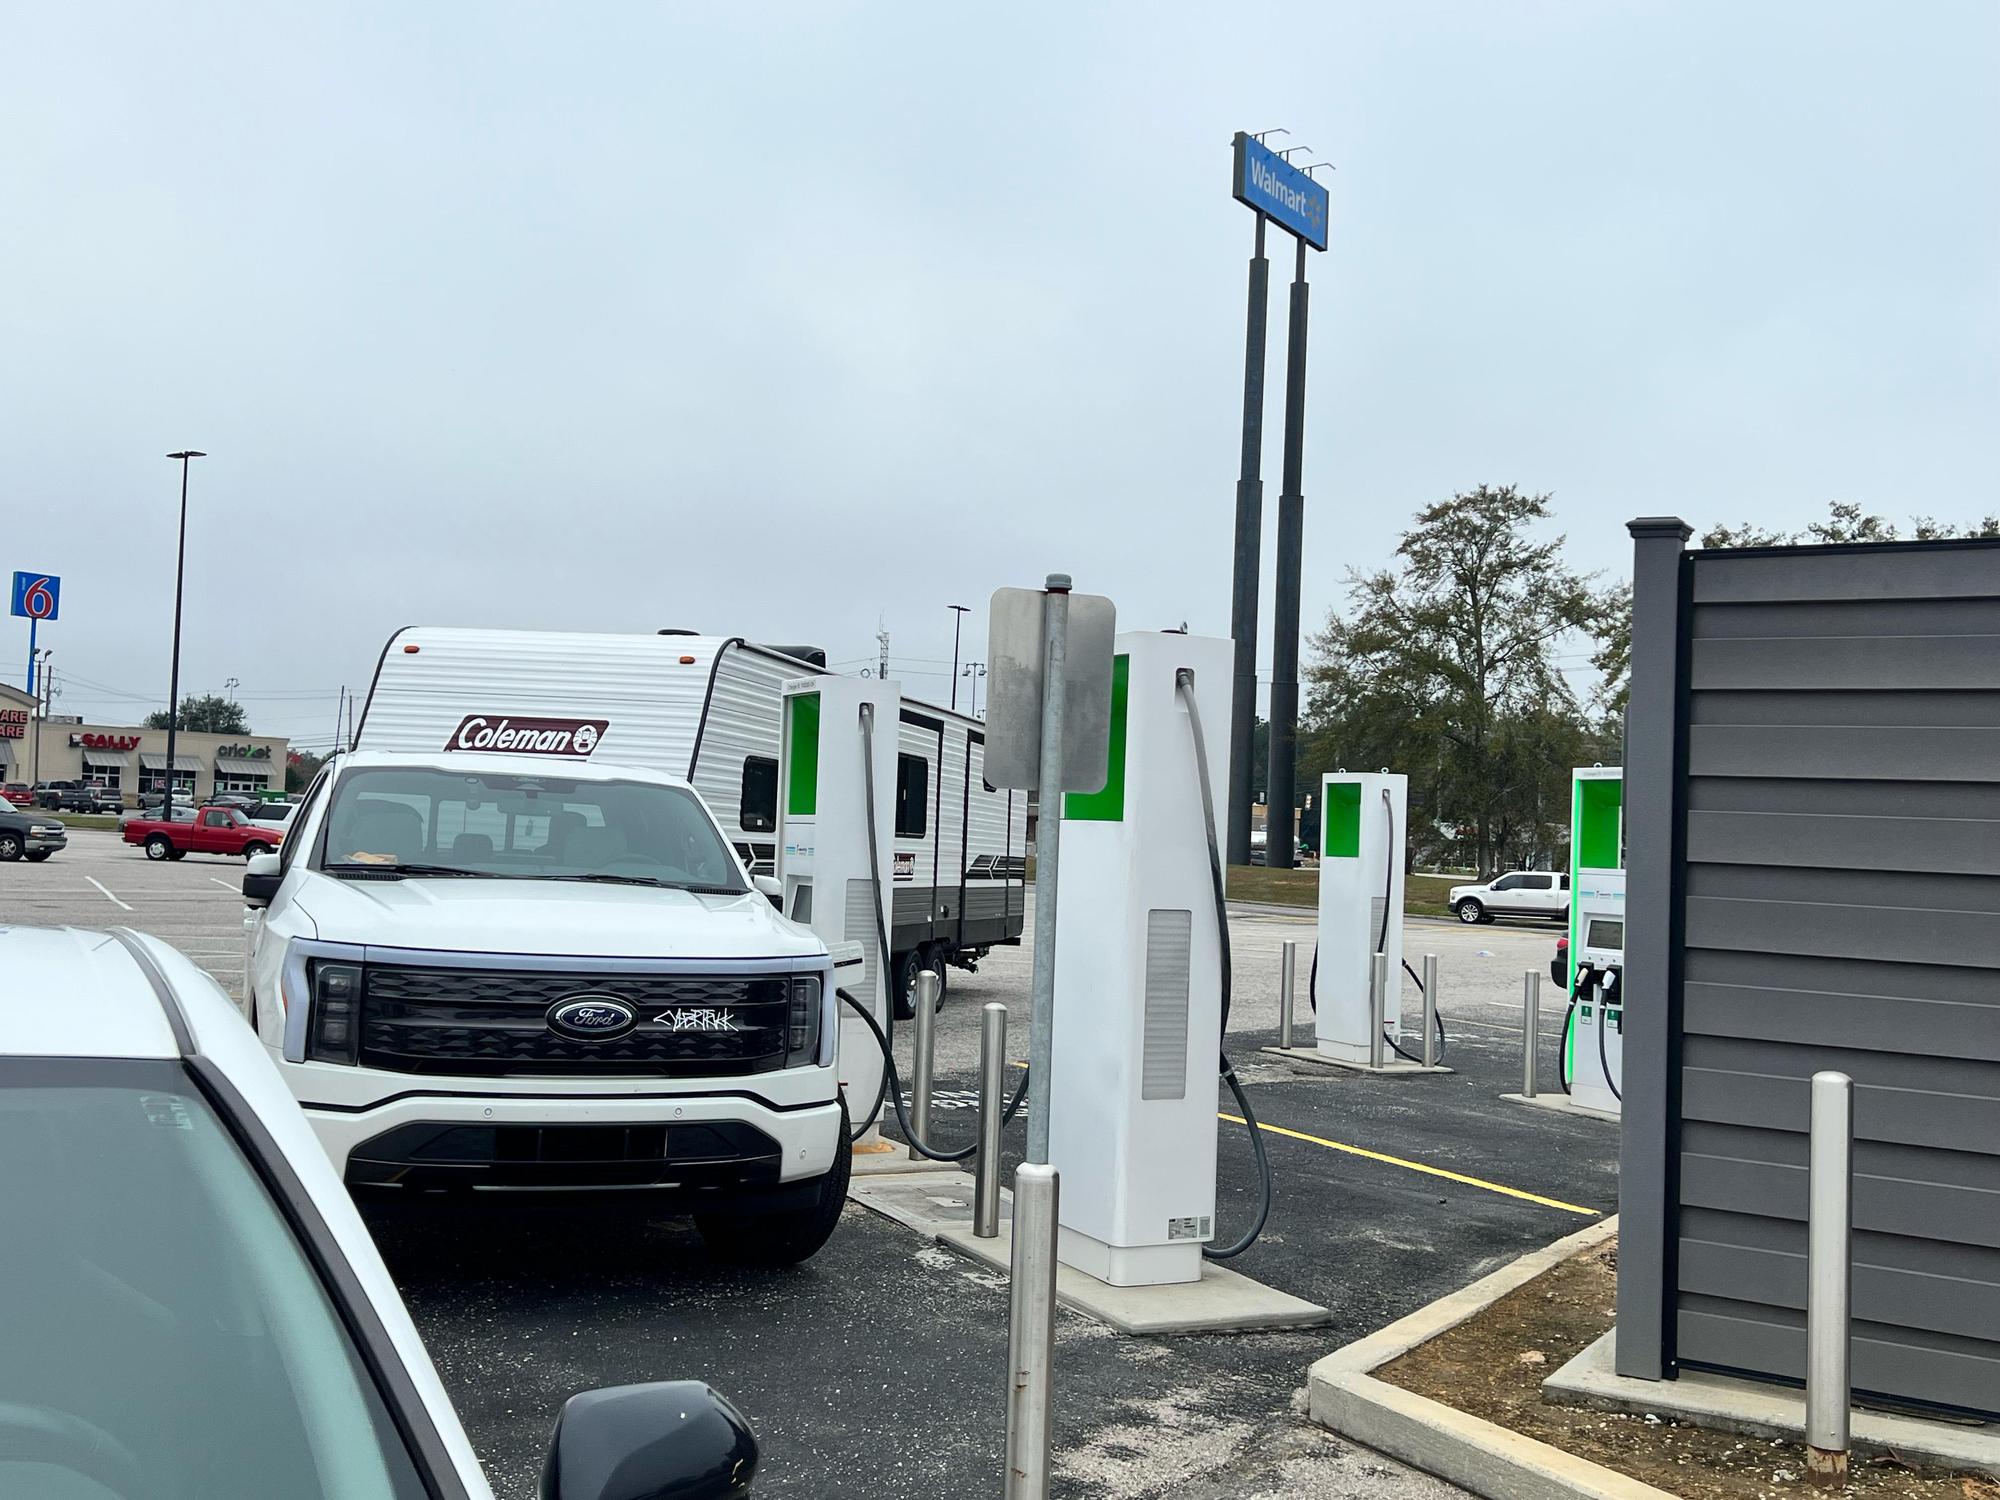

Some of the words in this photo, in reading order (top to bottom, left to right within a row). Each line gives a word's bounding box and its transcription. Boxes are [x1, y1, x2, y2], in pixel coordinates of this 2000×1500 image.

[1250, 156, 1307, 217] Walmart
[24, 577, 54, 619] 6
[81, 733, 141, 751] SALLY
[457, 717, 573, 751] Coleman
[217, 743, 272, 759] cricket
[573, 1007, 615, 1026] Ford
